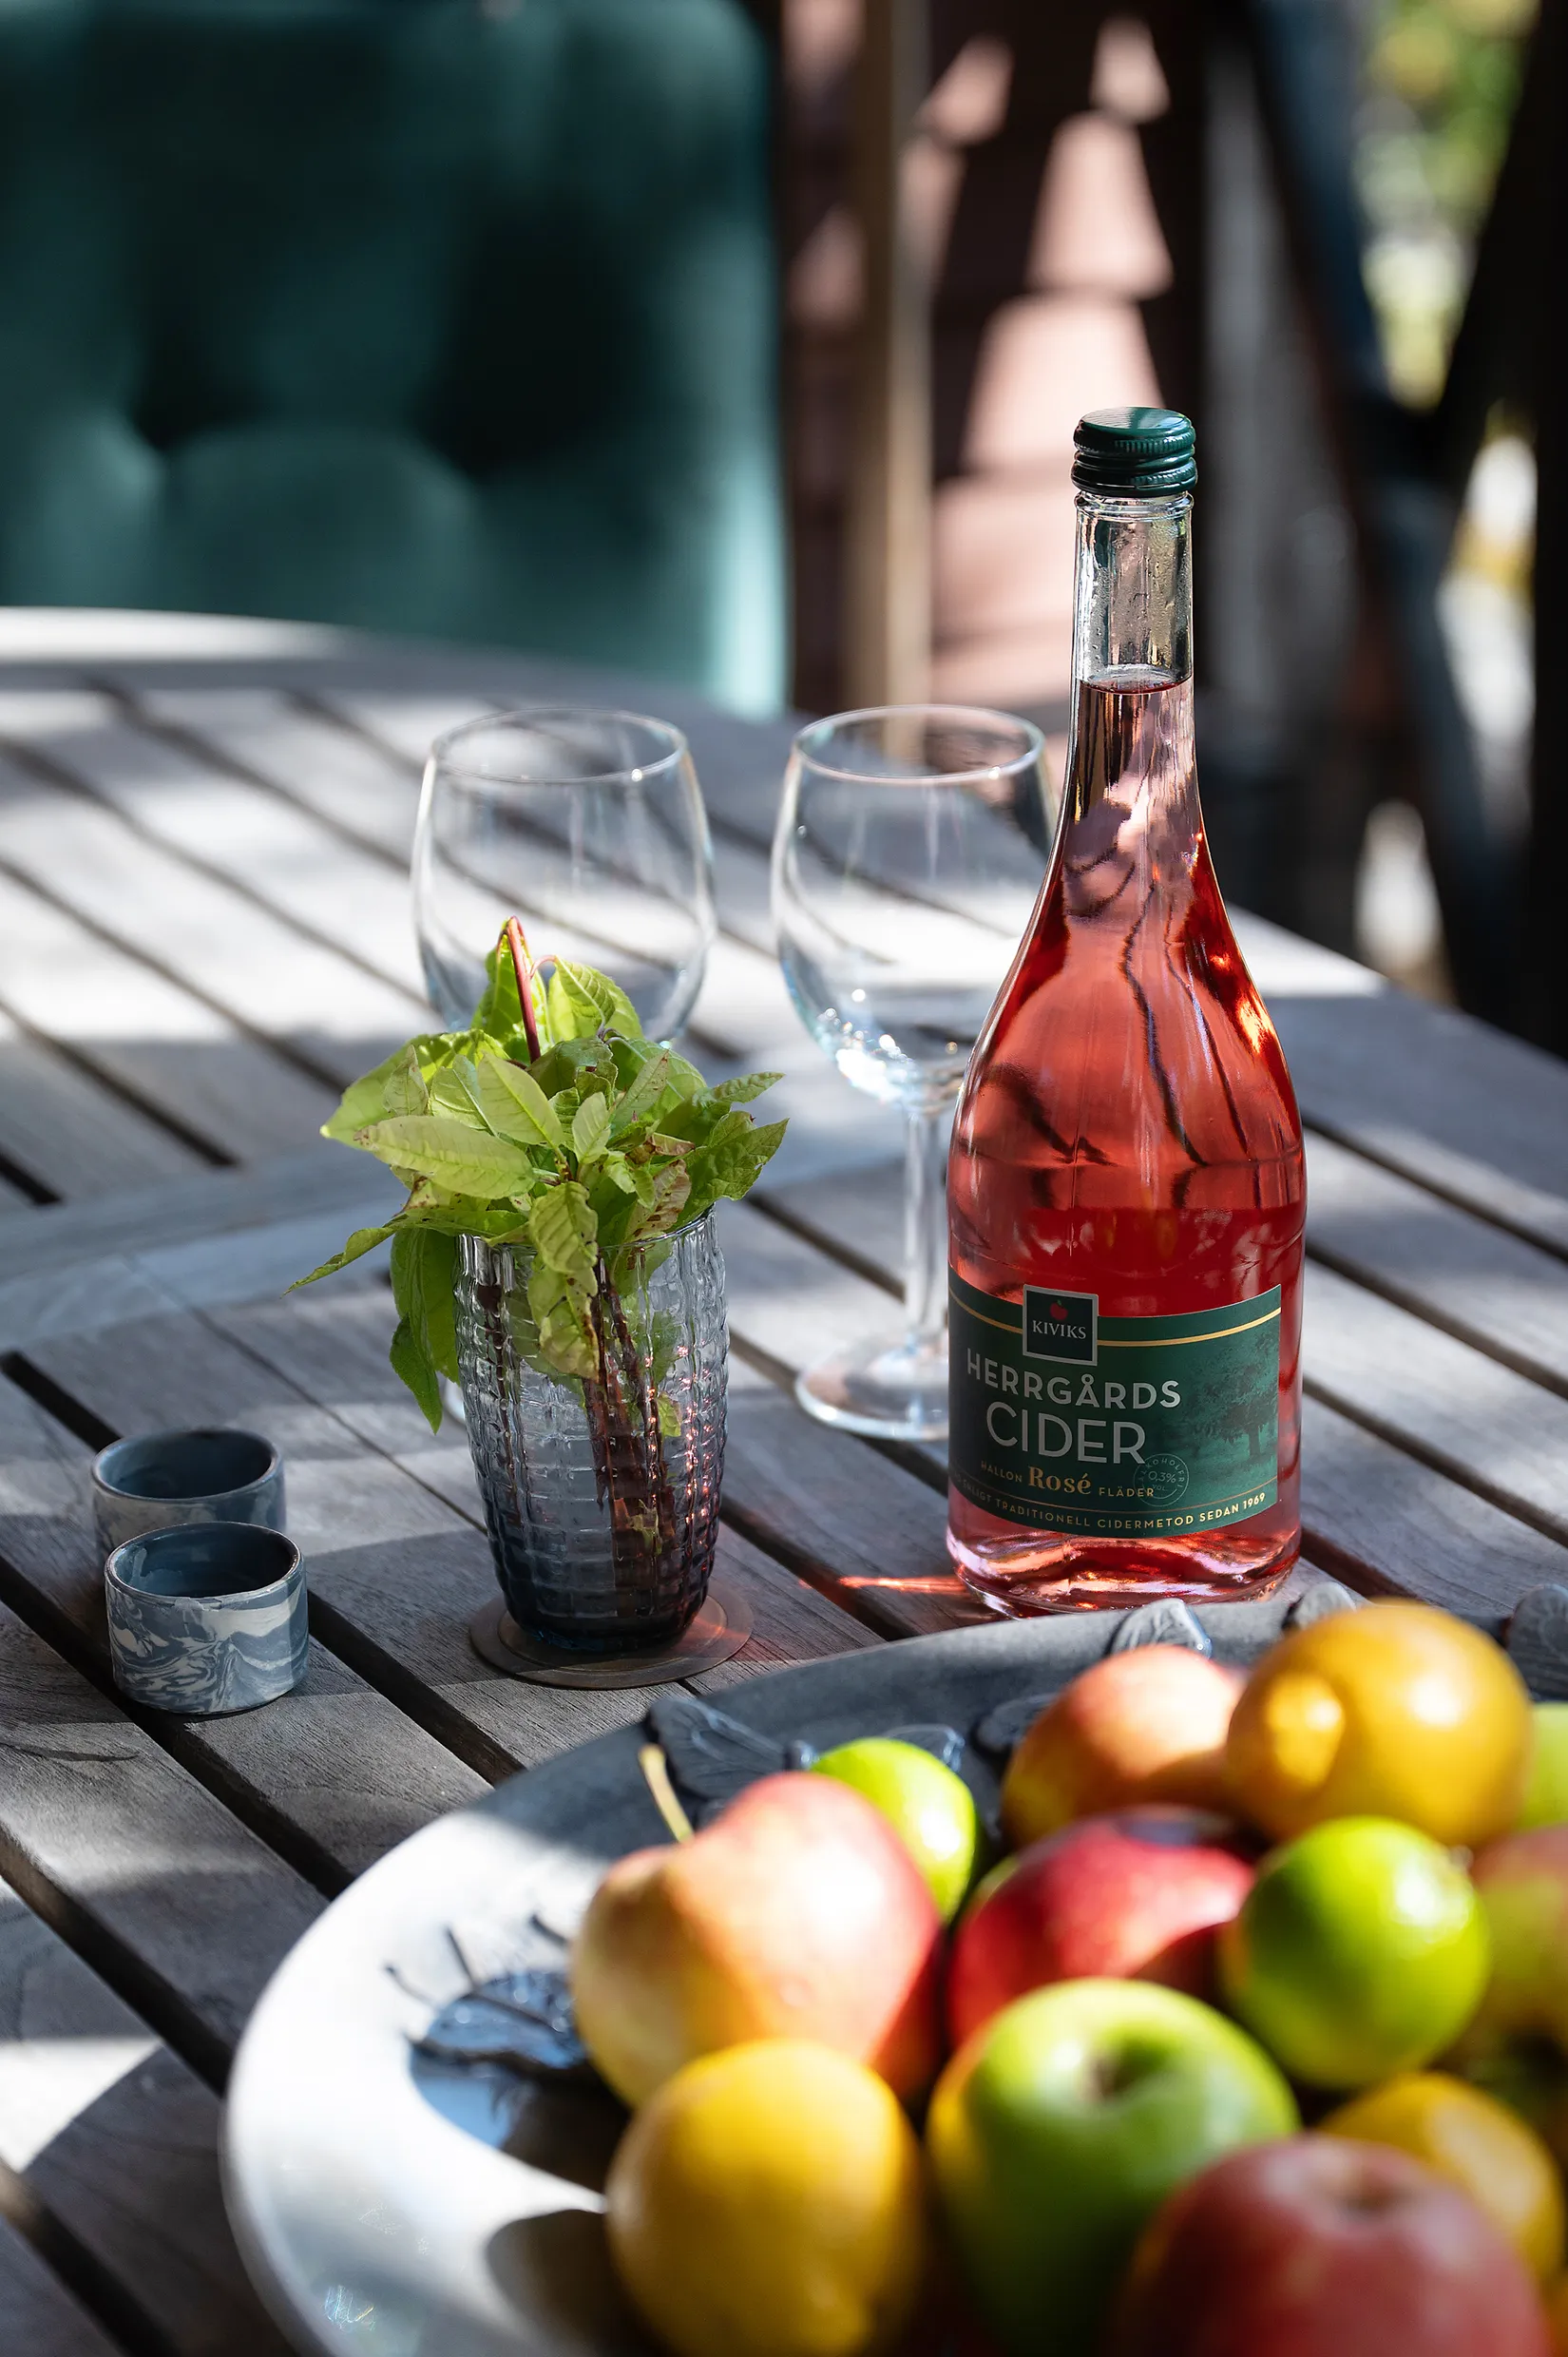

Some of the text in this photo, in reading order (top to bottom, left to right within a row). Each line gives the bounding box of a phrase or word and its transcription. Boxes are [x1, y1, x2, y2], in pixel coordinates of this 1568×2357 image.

[1032, 1320, 1087, 1340] KIVIKS
[966, 1348, 1182, 1410] HERRGÅRDS
[986, 1401, 1146, 1465] CIDER
[981, 1460, 1023, 1483] HALLON
[1028, 1466, 1092, 1495] Rosé
[1099, 1485, 1155, 1498] FLÄDER
[1148, 1470, 1176, 1484] 0,3%
[996, 1498, 1090, 1527] TRADITIONELL
[1097, 1515, 1194, 1529] CIDERMETOD
[1199, 1503, 1239, 1523] SEDAN
[1242, 1492, 1266, 1510] 1969
